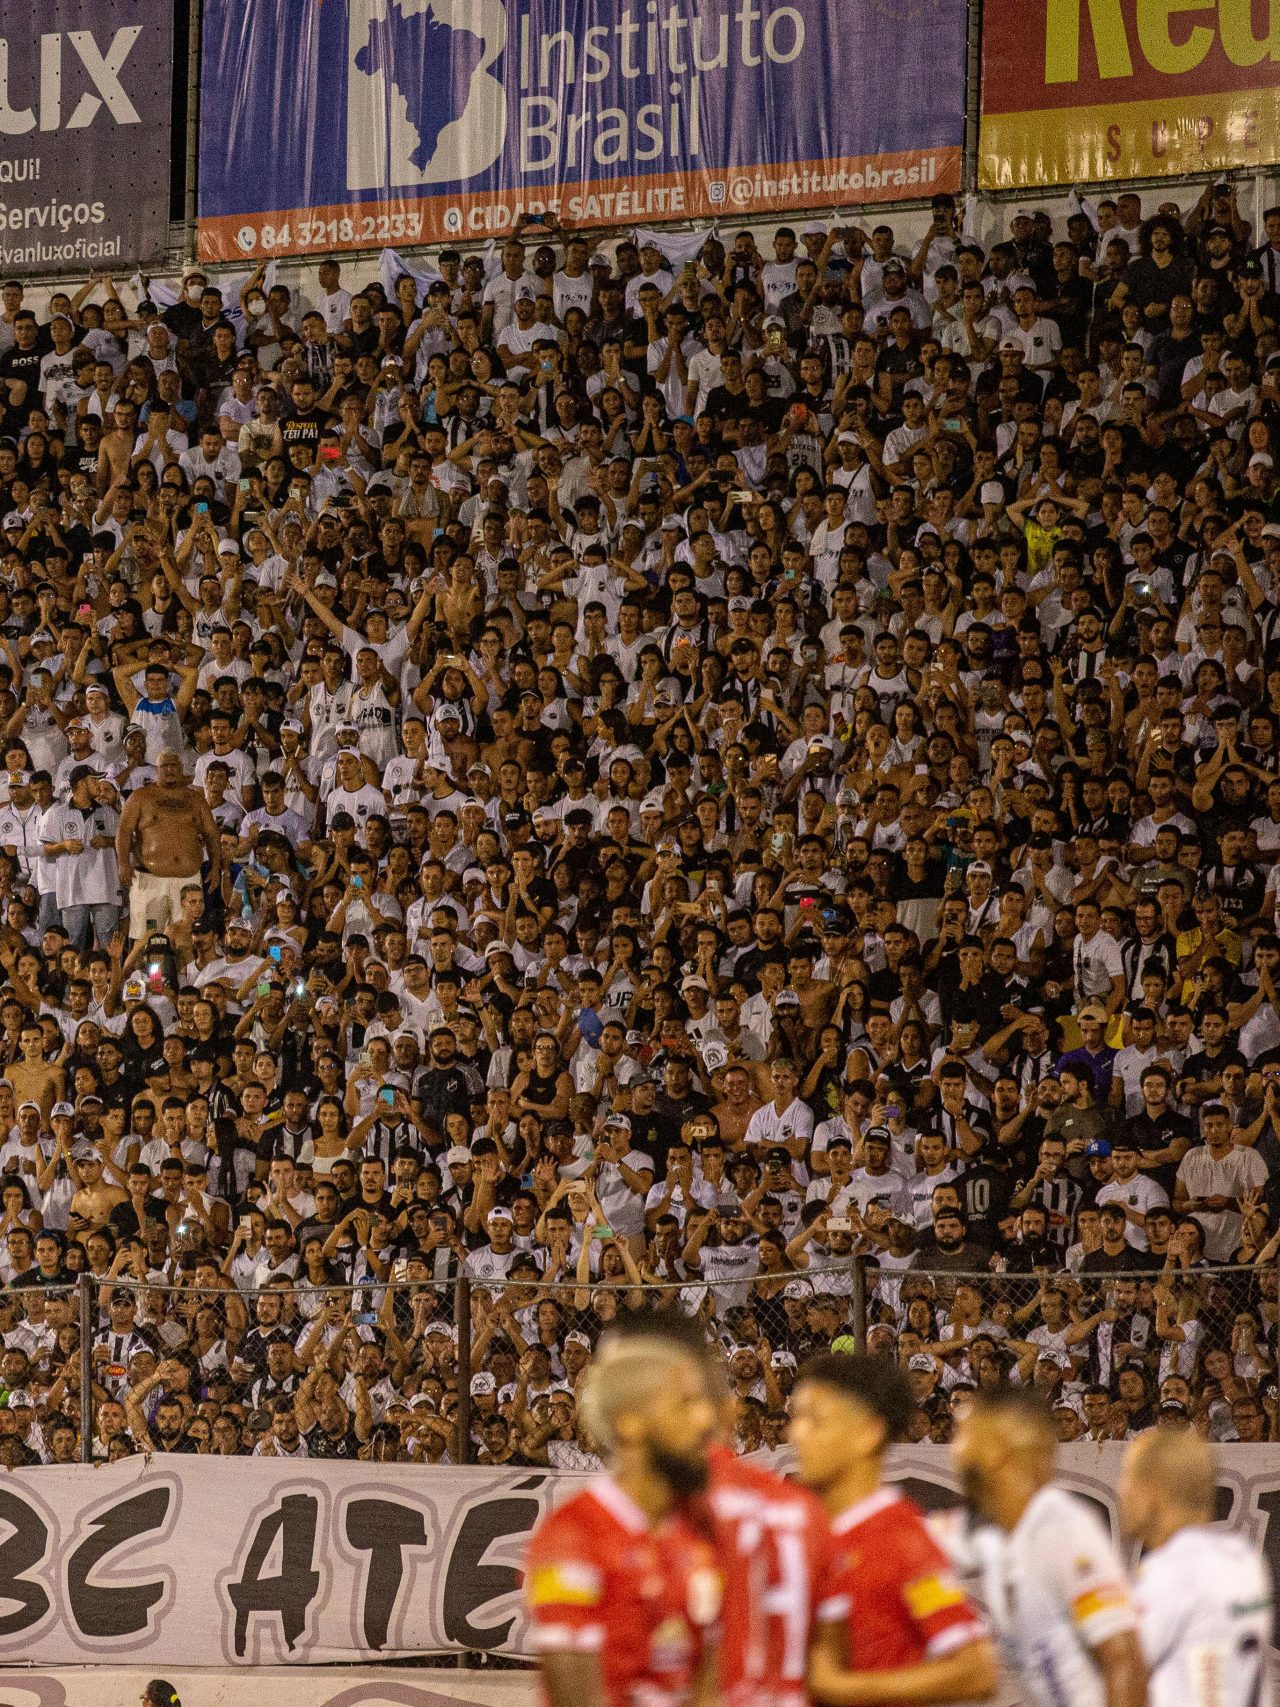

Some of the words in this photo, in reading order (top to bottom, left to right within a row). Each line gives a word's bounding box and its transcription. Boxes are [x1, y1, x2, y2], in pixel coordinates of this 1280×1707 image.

[520, 0, 805, 89] Instituto
[519, 74, 700, 172] Brasil
[729, 157, 936, 206] @institutobrasil
[568, 185, 686, 222] SATÉLITE
[261, 223, 292, 249] 84
[297, 211, 422, 246] 3218.2233
[11, 355, 39, 368] BOSS
[966, 1178, 990, 1214] 10
[227, 1474, 548, 1658] ATÉ
